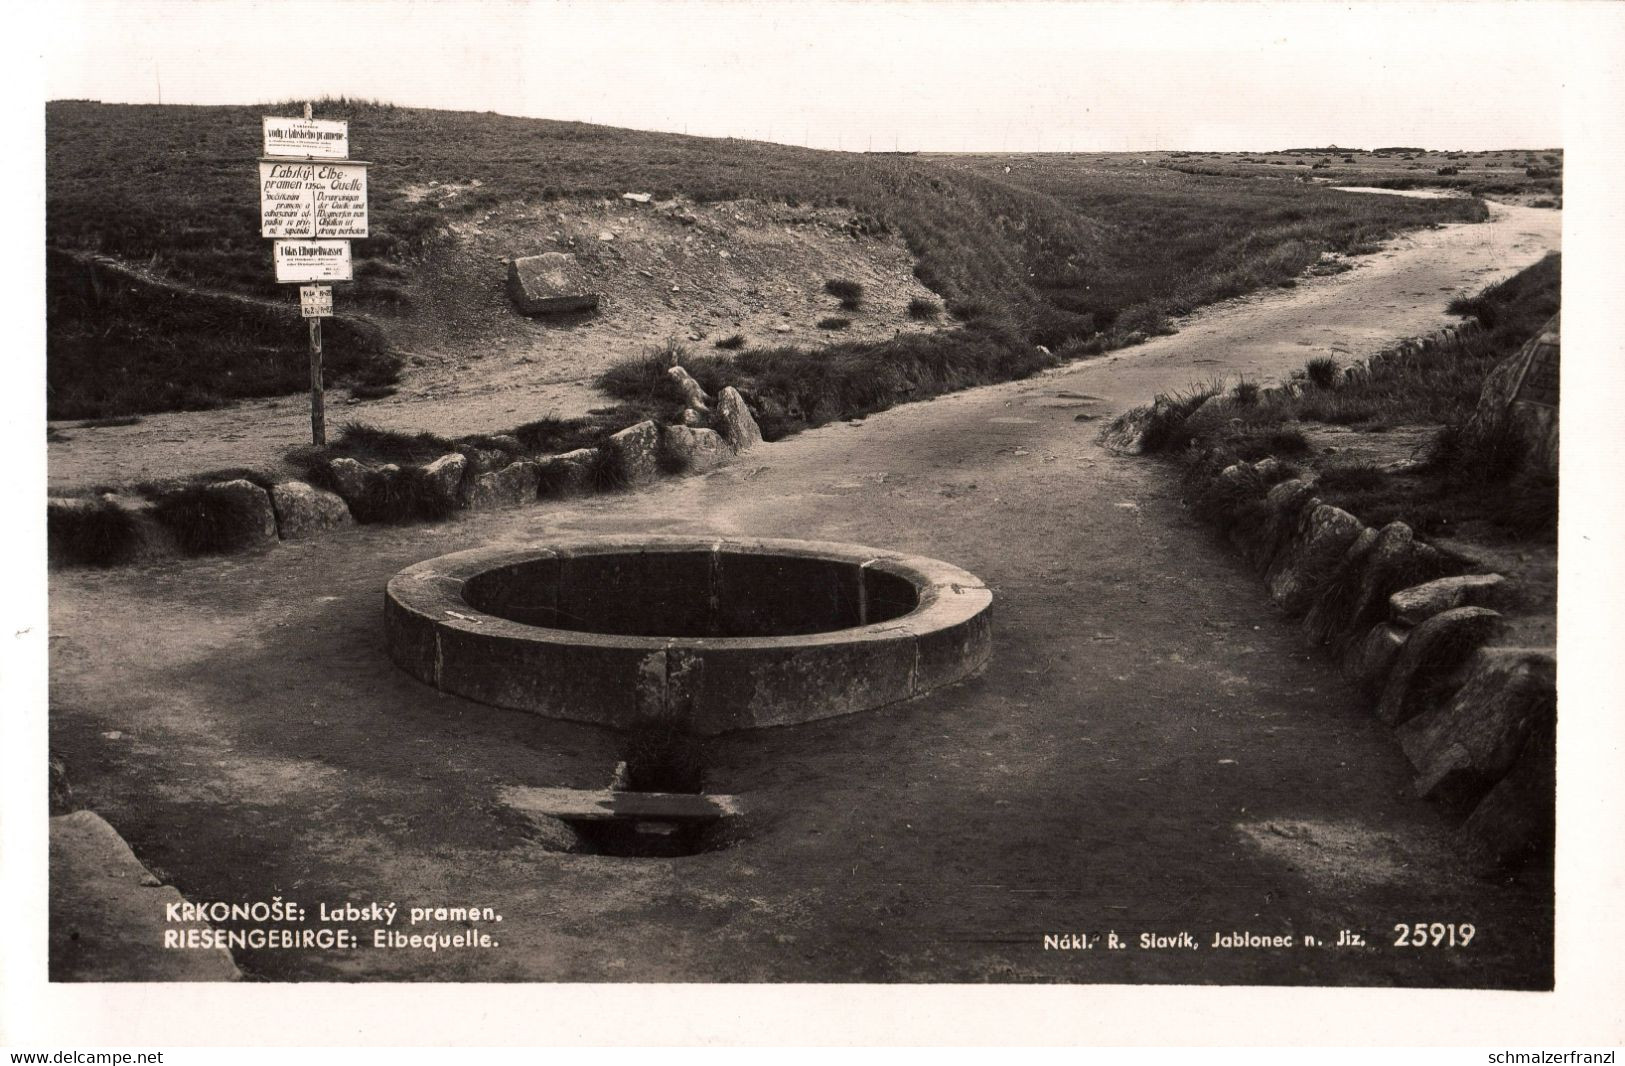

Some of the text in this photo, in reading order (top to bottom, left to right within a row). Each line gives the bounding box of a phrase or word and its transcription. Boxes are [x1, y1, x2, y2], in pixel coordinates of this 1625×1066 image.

[264, 180, 302, 191] pramen
[330, 179, 362, 191] Quelle
[284, 246, 297, 256] Glas
